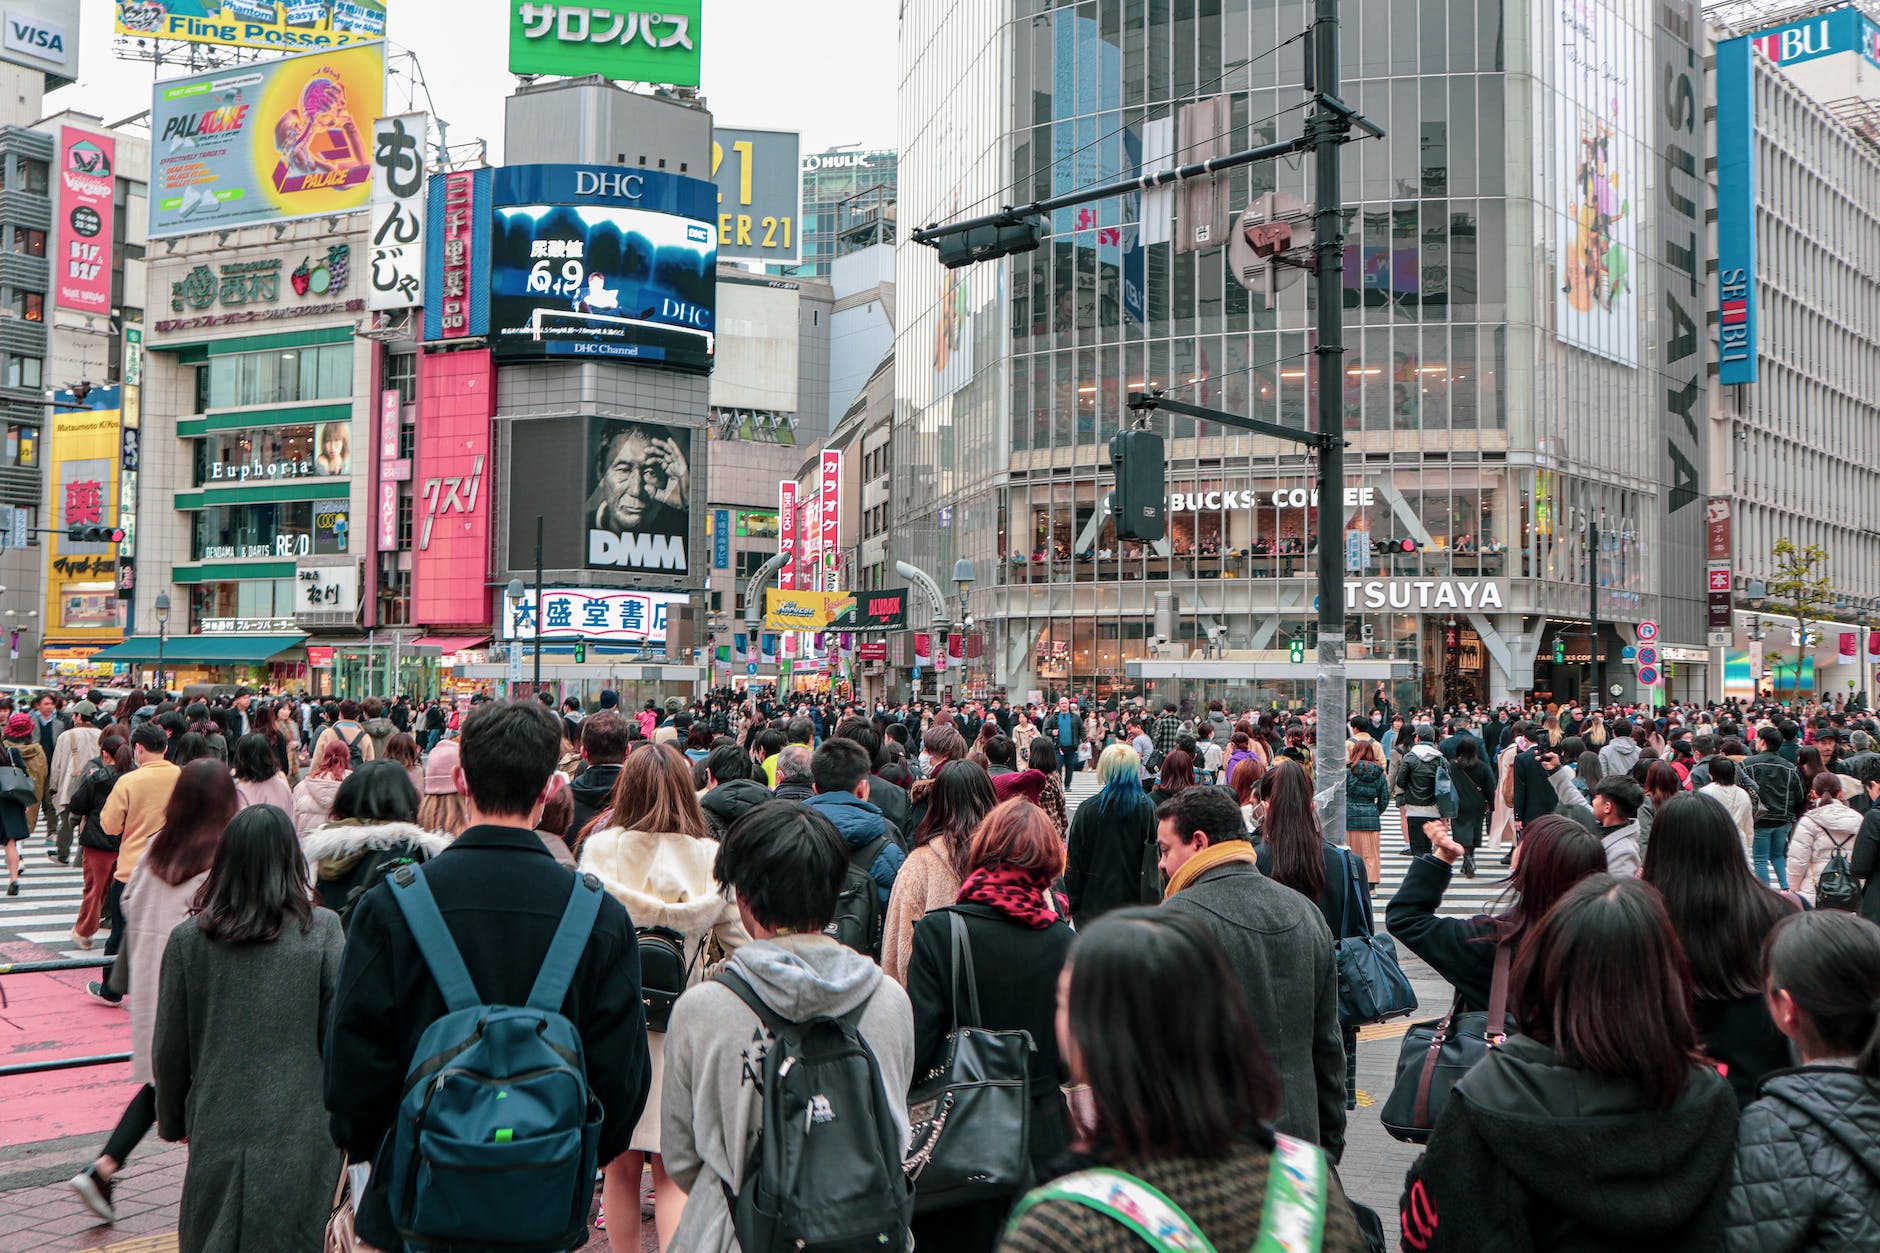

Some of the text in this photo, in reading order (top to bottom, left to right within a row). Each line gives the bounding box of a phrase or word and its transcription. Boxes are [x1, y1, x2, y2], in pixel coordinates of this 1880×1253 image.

[10, 20, 64, 53] VISA
[170, 16, 237, 41] Fling
[245, 24, 331, 47] Posse
[519, 2, 693, 50] サロンパス
[301, 169, 349, 190] PALACE
[575, 171, 644, 199] DHC
[371, 119, 423, 302] もんじゃ
[688, 227, 707, 240] DHC
[761, 216, 791, 249] 21
[70, 240, 101, 260] B1F
[441, 177, 468, 328] 三千里薬品
[69, 260, 101, 280] B2F
[663, 298, 710, 327] DHC
[1721, 267, 1747, 363] SEIBU
[575, 343, 638, 356] DHC Channel
[57, 422, 98, 433] Matsumoto
[211, 457, 309, 481] Euphoria
[65, 480, 102, 525] 薬
[419, 455, 485, 551] クスリ
[822, 461, 838, 531] カラオケ
[241, 547, 247, 558] &
[248, 545, 270, 558] DARTS
[276, 534, 310, 557] RE/D
[589, 529, 687, 570] DMM
[1711, 572, 1728, 588] 本
[1343, 581, 1503, 609] TSUTAYA
